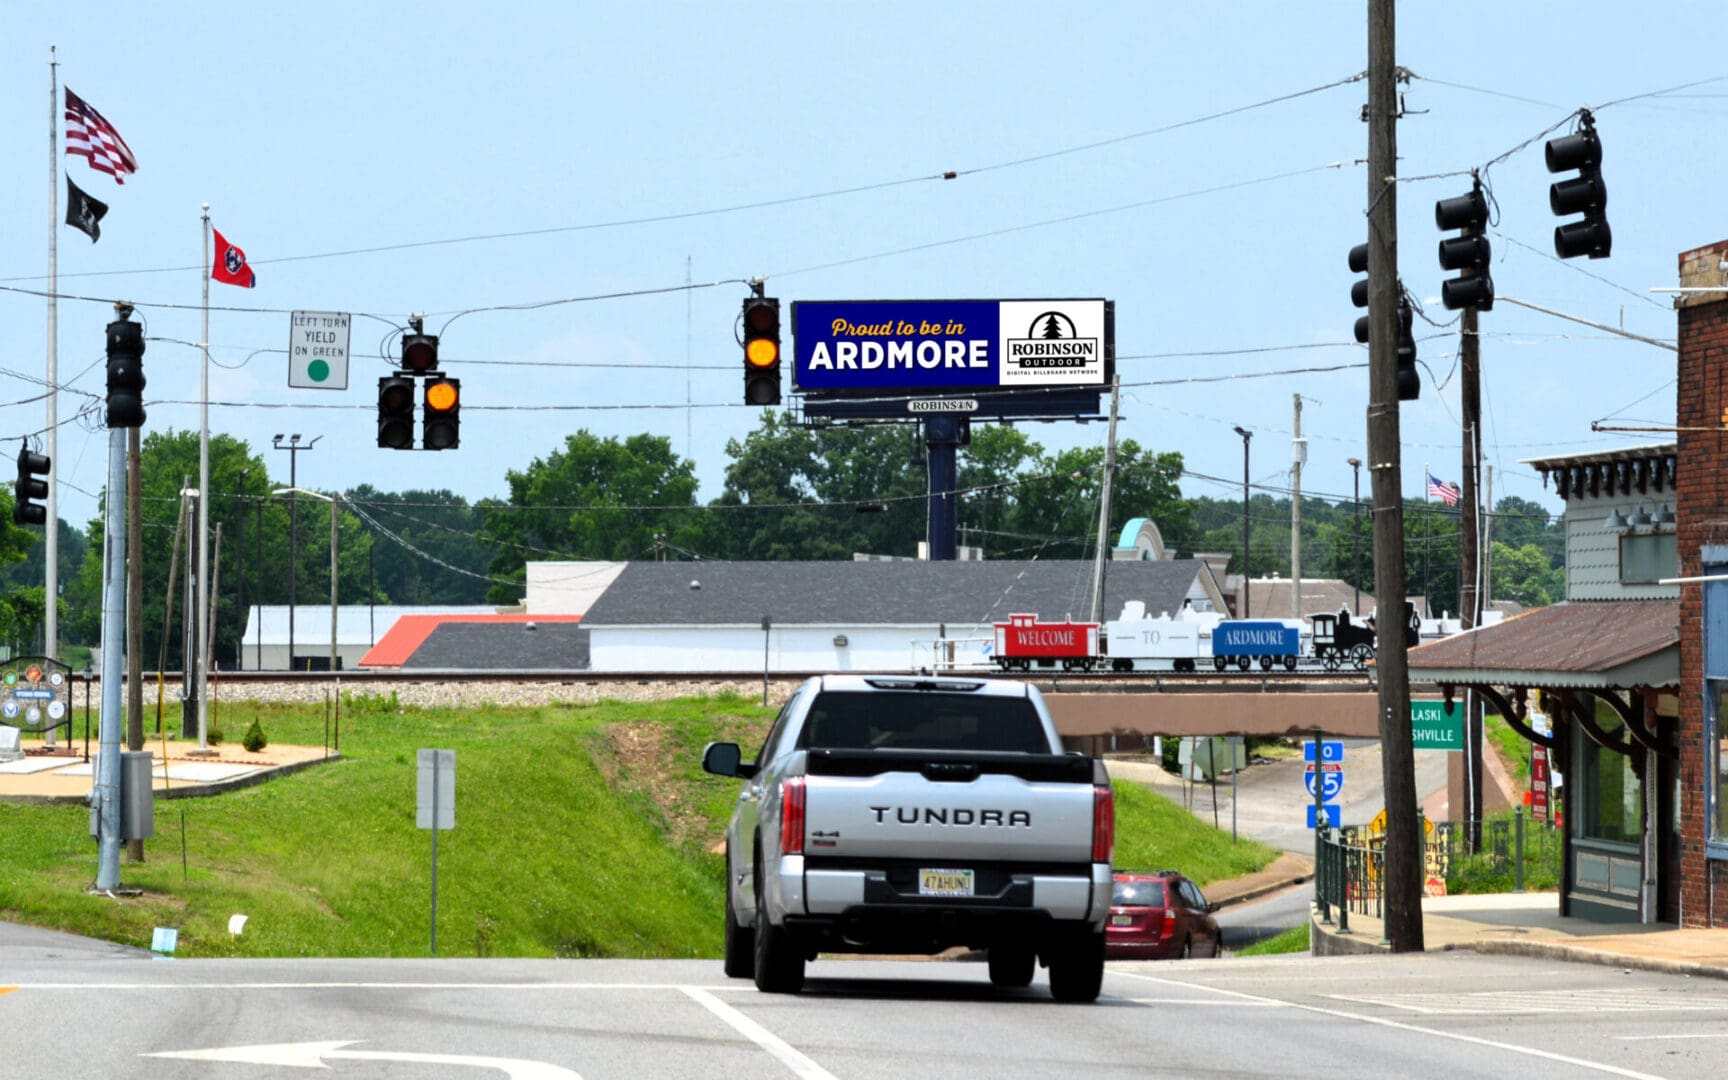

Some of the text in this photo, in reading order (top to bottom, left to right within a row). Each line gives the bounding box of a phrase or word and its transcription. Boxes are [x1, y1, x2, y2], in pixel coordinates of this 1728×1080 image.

[294, 317, 347, 328] LEFT TURN
[831, 318, 966, 337] Proud to be in
[305, 331, 336, 343] YIELD
[295, 346, 344, 357] ON GREEN
[808, 340, 989, 370] ARDMORE
[1012, 342, 1093, 356] ROBINSON
[1024, 358, 1080, 367] OUTDOOR
[1017, 630, 1075, 646] WELCOME
[1142, 630, 1160, 645] TO
[1224, 629, 1284, 646] ARDMORE
[1411, 709, 1441, 721] LASKI
[1412, 729, 1454, 742] SHVILLE
[1309, 773, 1339, 795] 65
[869, 806, 1032, 828] TUNDRA
